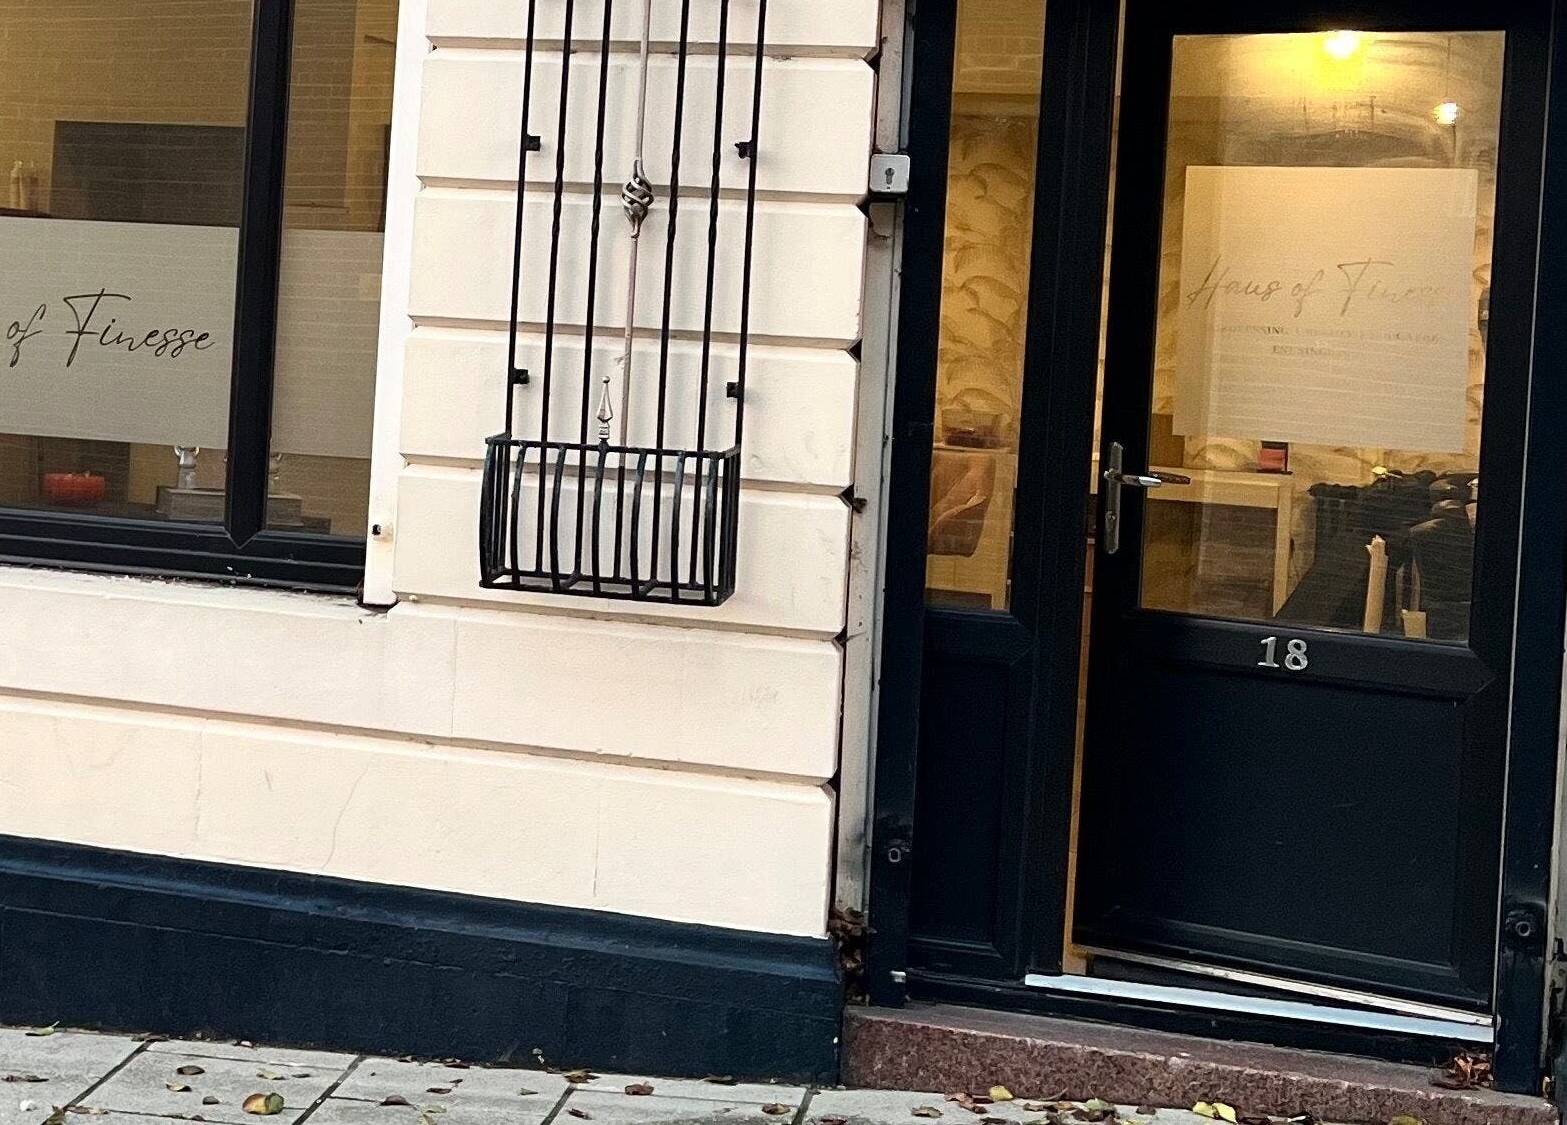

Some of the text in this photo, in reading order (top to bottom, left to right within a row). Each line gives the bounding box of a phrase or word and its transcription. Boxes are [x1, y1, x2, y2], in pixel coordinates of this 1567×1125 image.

[1186, 255, 1282, 310] Haus
[1291, 269, 1325, 318] of
[6, 304, 47, 368] of
[63, 288, 216, 368] Finesse
[1257, 636, 1309, 671] 18
